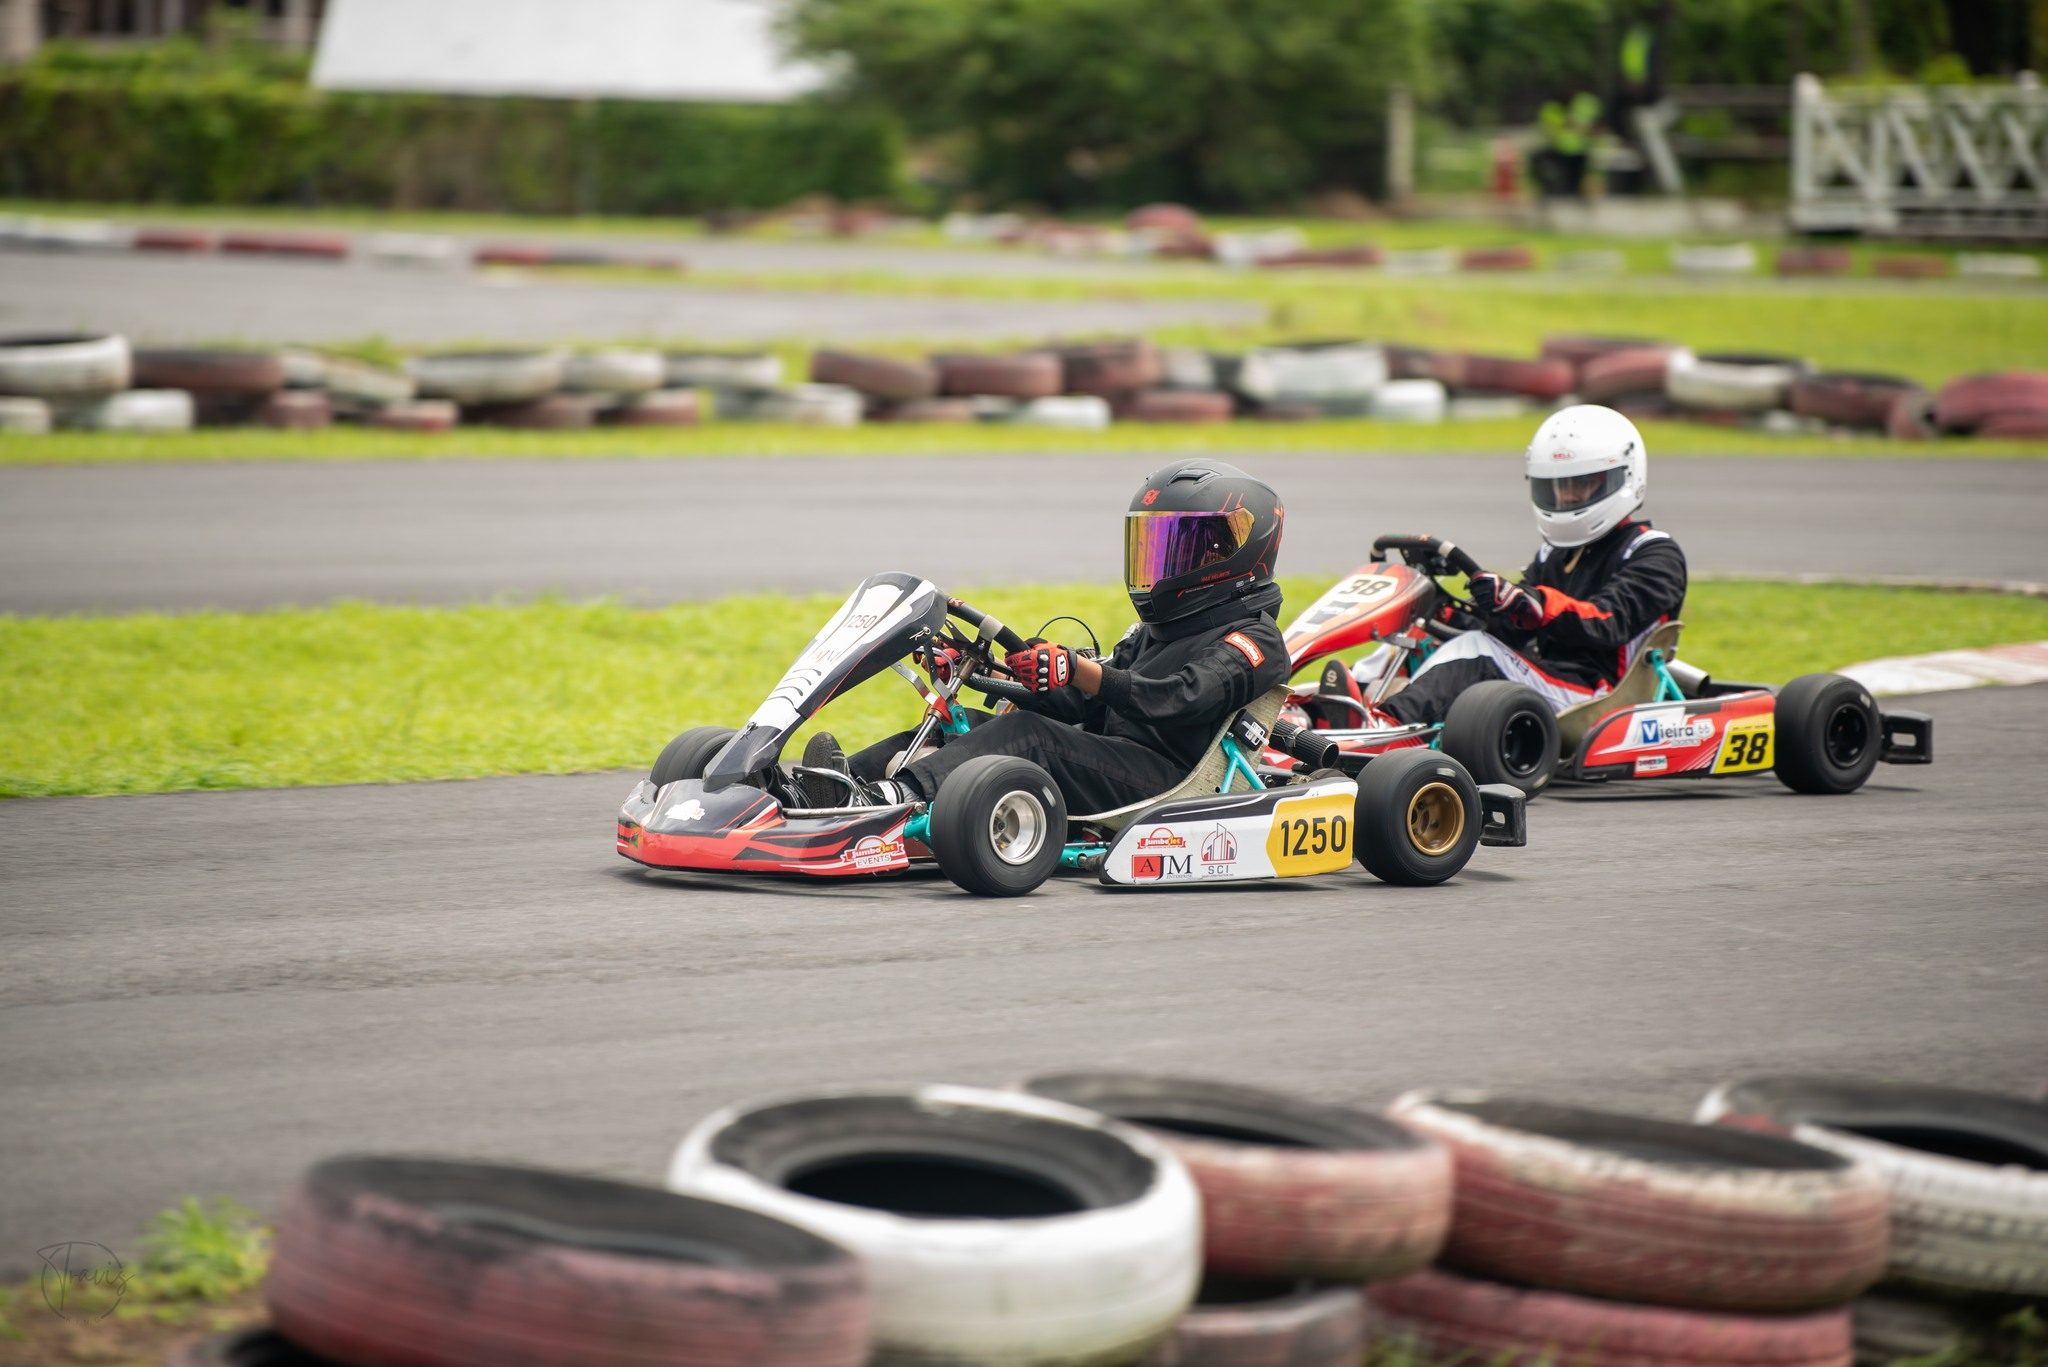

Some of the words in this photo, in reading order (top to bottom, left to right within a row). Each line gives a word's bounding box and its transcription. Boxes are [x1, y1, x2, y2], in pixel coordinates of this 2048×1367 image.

[1338, 579, 1392, 596] 38
[843, 614, 878, 629] 1250
[1642, 722, 1694, 741] Vieira
[1723, 732, 1769, 767] 38
[1281, 815, 1347, 857] 1250
[858, 855, 891, 866] EVENTS
[1140, 854, 1194, 881] AJM
[1208, 865, 1229, 875] SCI
